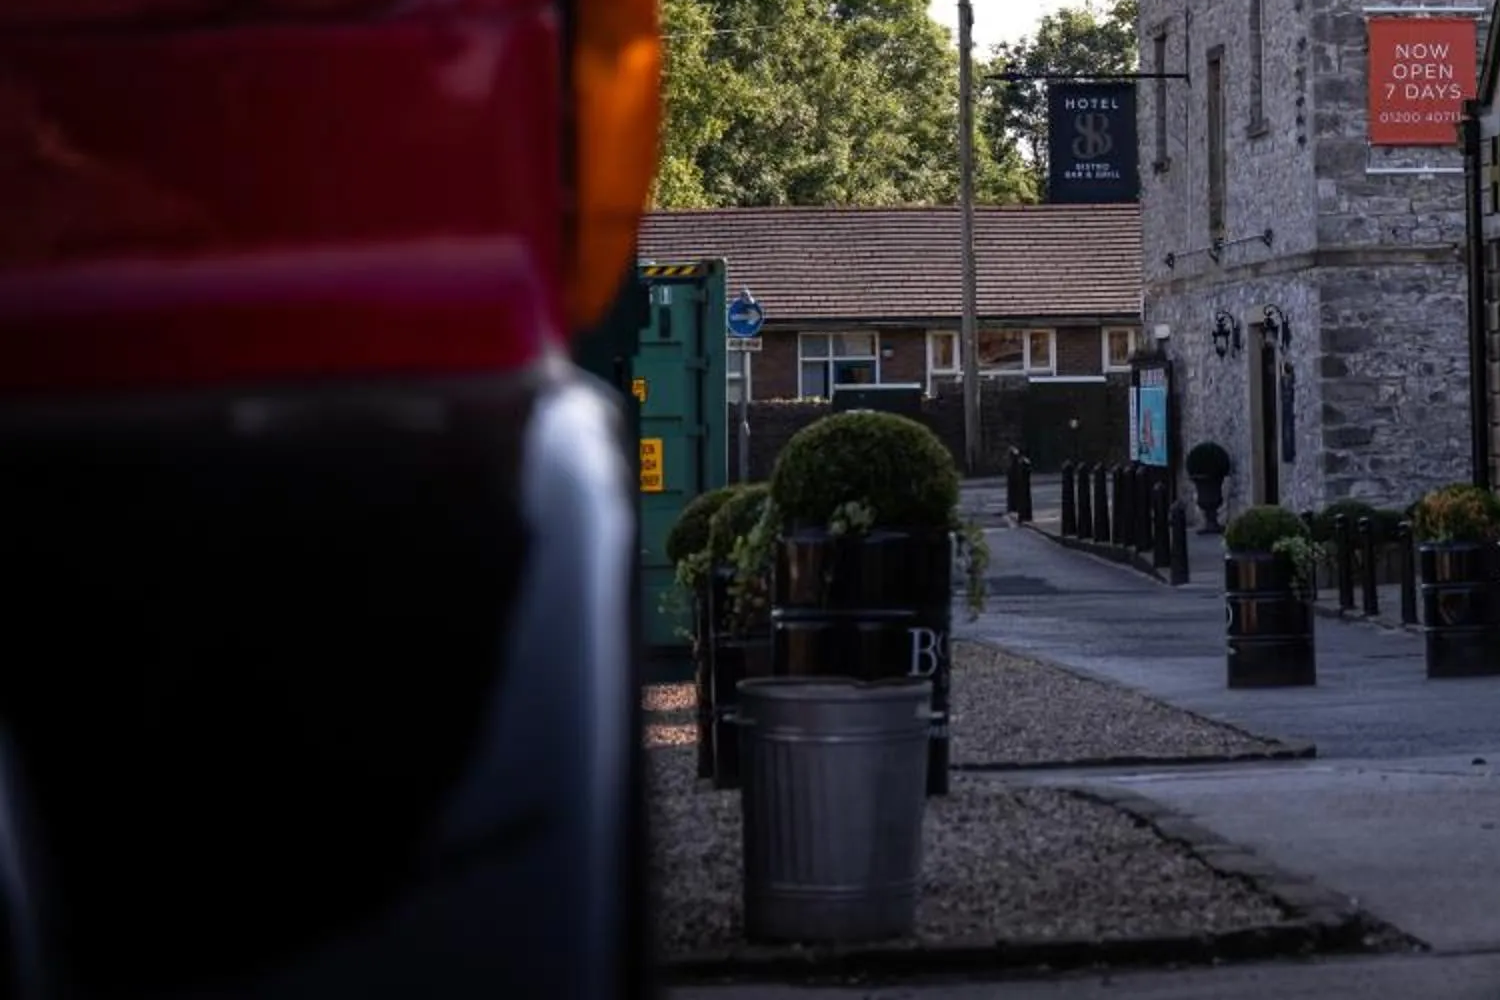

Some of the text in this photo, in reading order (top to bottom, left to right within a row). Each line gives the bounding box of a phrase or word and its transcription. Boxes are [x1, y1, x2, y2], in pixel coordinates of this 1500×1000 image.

[1395, 43, 1449, 60] NOW
[1392, 63, 1453, 80] OPEN
[1384, 83, 1461, 100] 7 DAYS
[1065, 98, 1120, 110] HOTEL
[1379, 111, 1462, 123] 01200 40711
